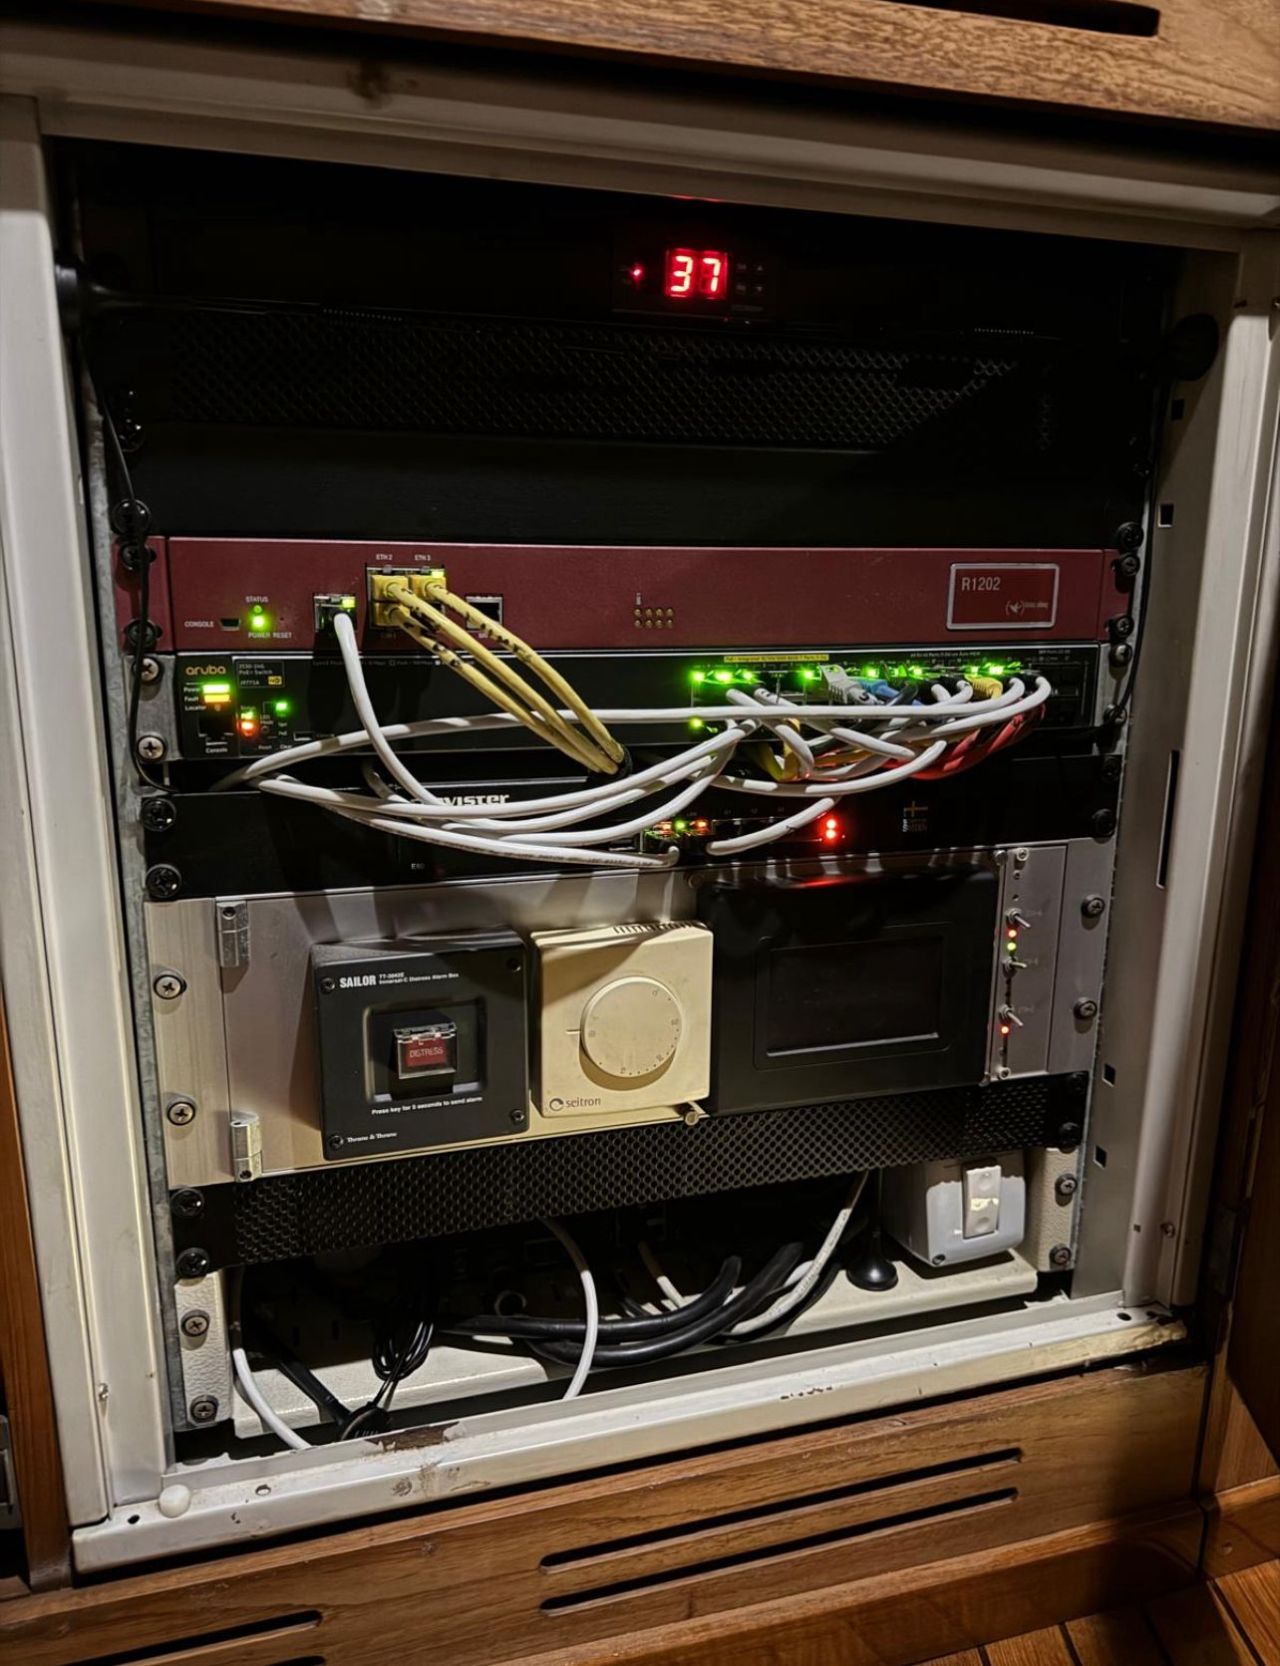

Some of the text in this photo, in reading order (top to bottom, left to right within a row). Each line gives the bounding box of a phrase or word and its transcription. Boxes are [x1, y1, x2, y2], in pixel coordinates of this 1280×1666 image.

[670, 254, 722, 293] 37
[961, 576, 1001, 591] R1202
[245, 595, 269, 603] STATUS
[184, 620, 214, 628] CONSOLE
[272, 631, 293, 639] RESET
[185, 664, 227, 676] aruba
[339, 975, 377, 989] SAILOR
[565, 1096, 602, 1108] seitron
